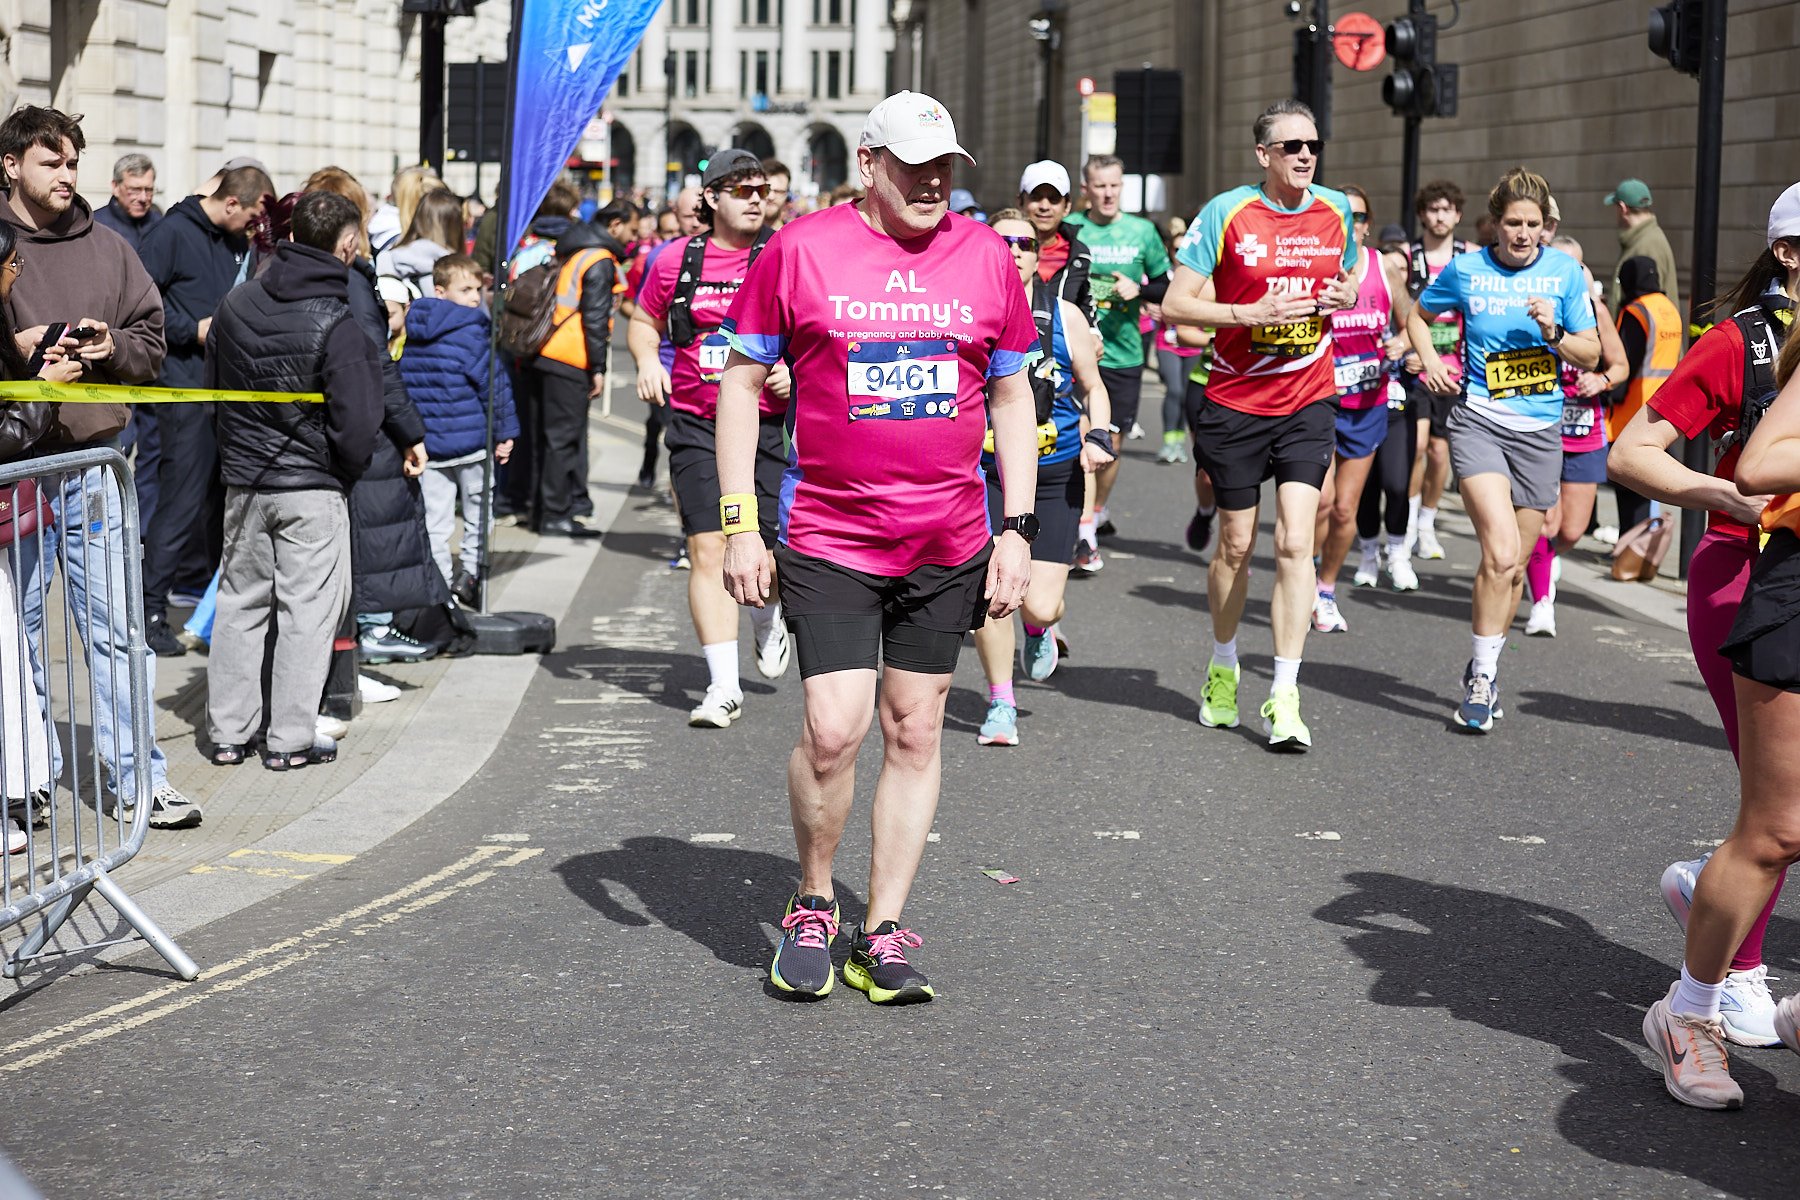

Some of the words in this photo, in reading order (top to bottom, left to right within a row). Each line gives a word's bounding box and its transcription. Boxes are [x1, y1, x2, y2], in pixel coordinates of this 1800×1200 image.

[1275, 235, 1320, 246] London's
[1275, 247, 1291, 257] Air
[1275, 257, 1312, 269] Charity
[885, 269, 927, 293] AL
[1266, 277, 1316, 296] TONY
[1470, 275, 1508, 292] PHIL
[1512, 277, 1562, 293] CLIFT
[828, 295, 974, 328] Tommy's
[1488, 306, 1506, 315] UK
[828, 329, 844, 338] The
[847, 330, 896, 340] pregnancy
[898, 330, 916, 338] and
[918, 330, 942, 339] baby
[944, 331, 974, 344] charity
[897, 345, 911, 354] AL
[865, 364, 938, 391] 9461
[1492, 359, 1552, 383] 12863
